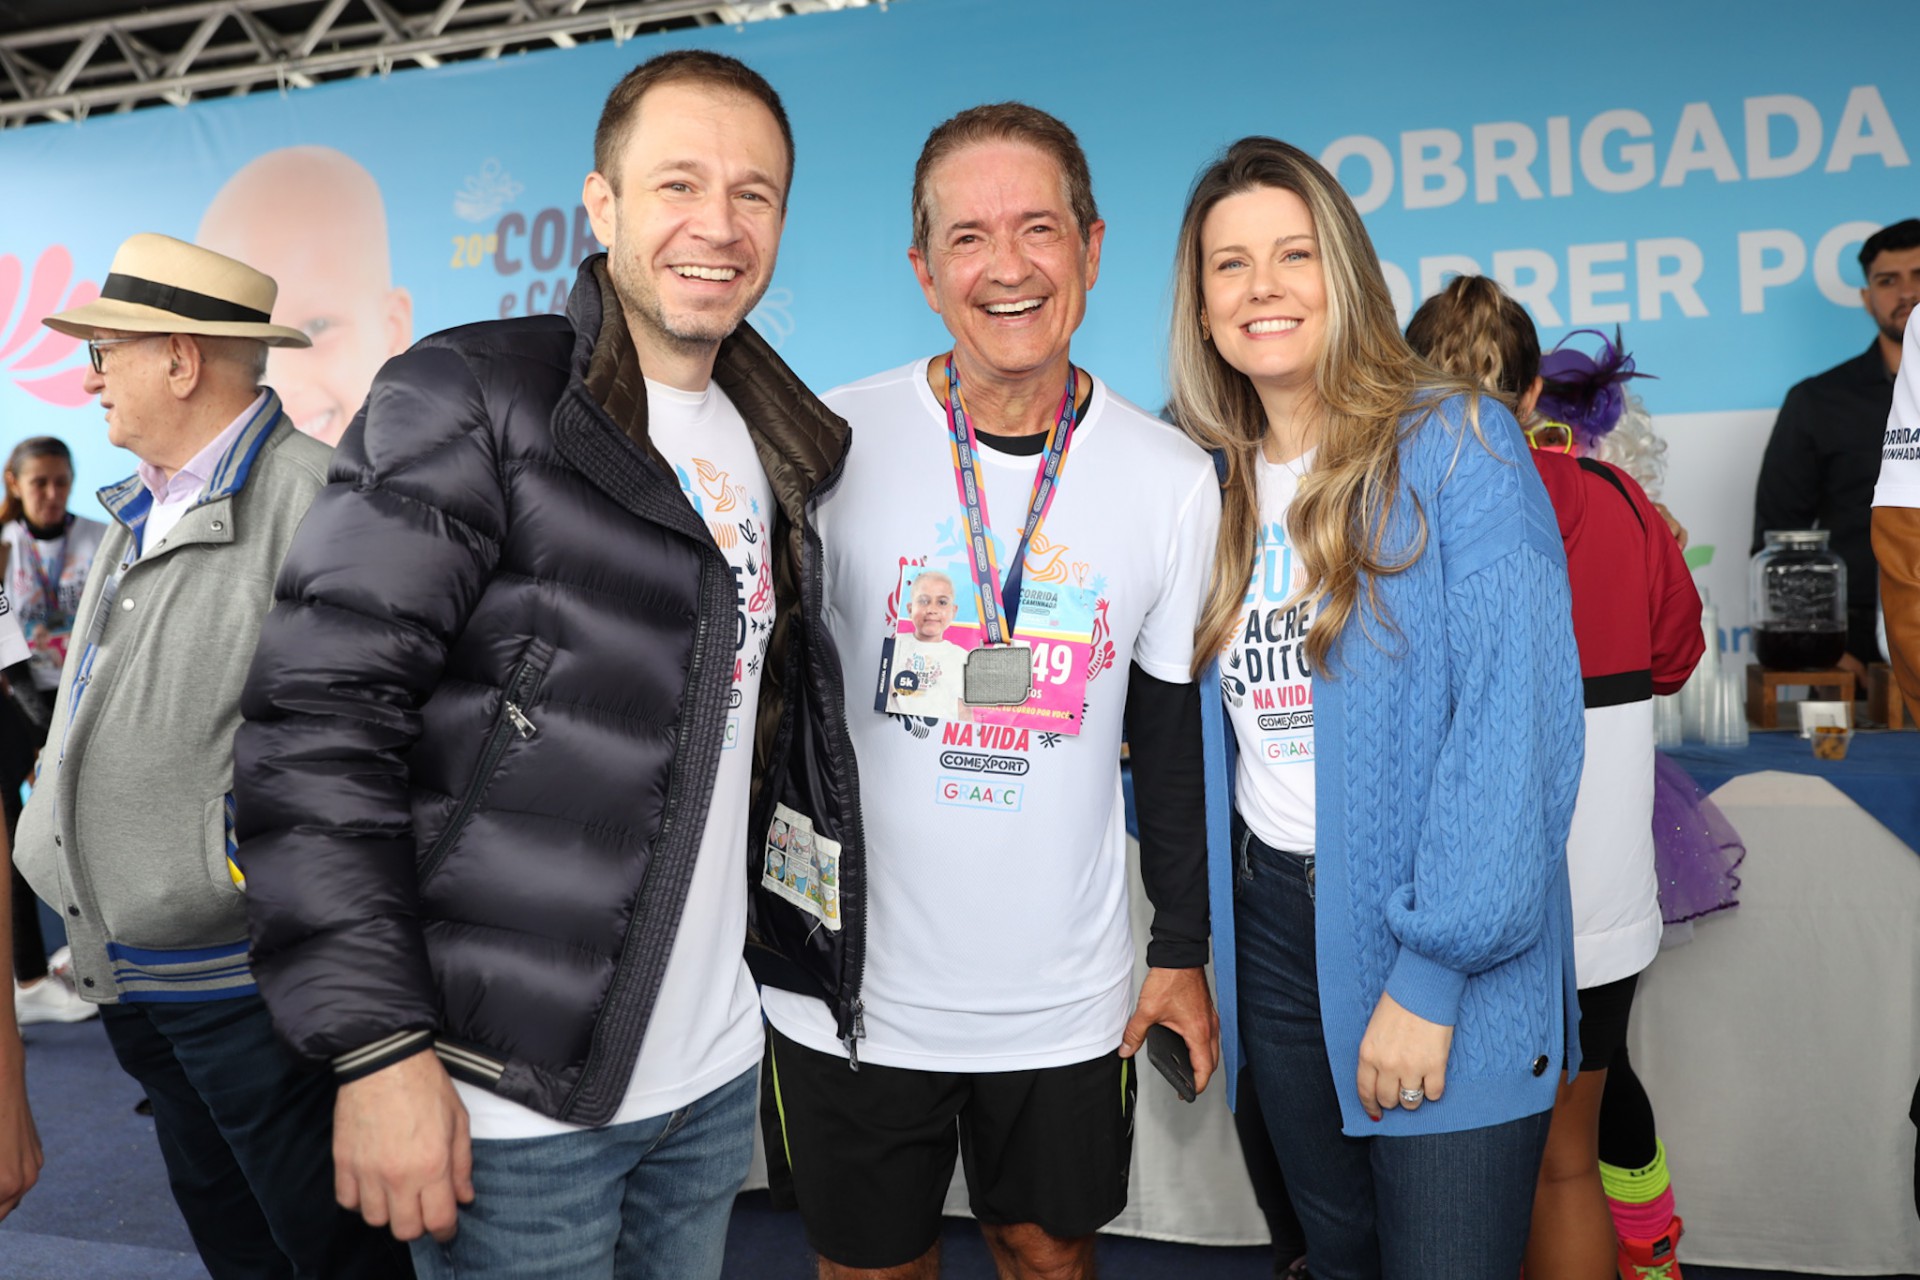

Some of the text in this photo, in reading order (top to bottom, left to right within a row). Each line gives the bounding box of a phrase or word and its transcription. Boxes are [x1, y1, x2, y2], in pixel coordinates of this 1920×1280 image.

[1319, 84, 1911, 214] OBRIGADA
[1738, 220, 1886, 314] PO
[1883, 446, 1920, 460] INHADA
[1244, 600, 1311, 644] ACRE
[992, 639, 1073, 685] 49
[1245, 641, 1313, 684] DITO
[899, 676, 914, 688] 5k
[1253, 688, 1275, 710] NA
[1260, 714, 1314, 728] COMEXPOR
[942, 722, 1029, 752] NA VIDA
[1268, 741, 1314, 759] GRAAC
[944, 754, 1024, 772] COMEXPORT
[944, 783, 1016, 805] GRAACC
